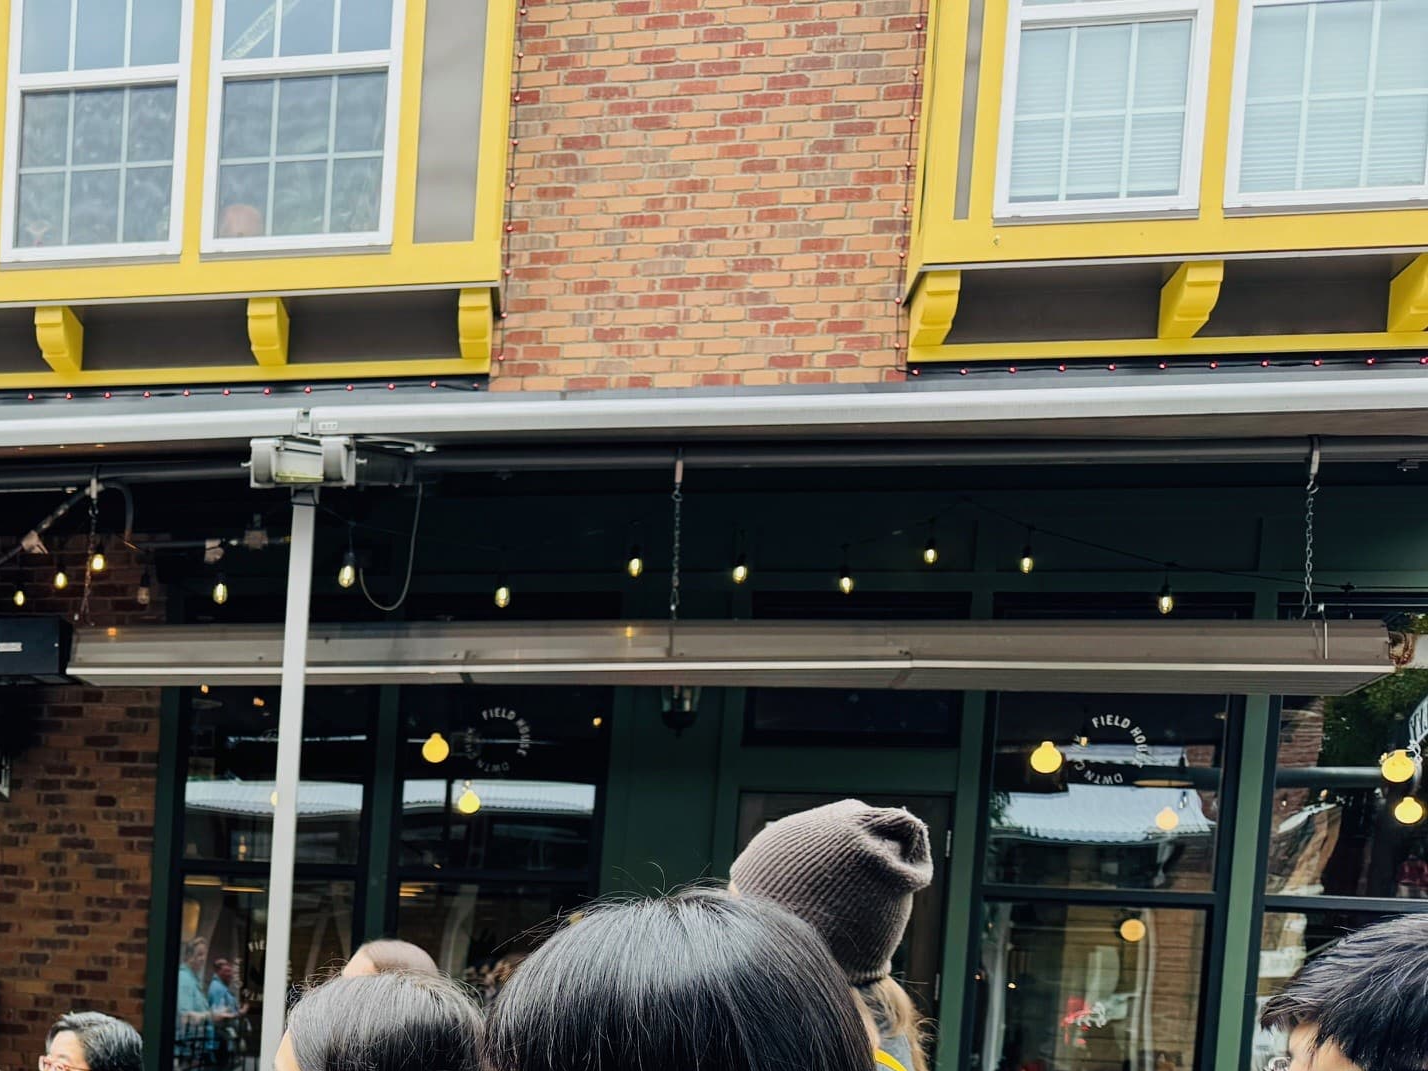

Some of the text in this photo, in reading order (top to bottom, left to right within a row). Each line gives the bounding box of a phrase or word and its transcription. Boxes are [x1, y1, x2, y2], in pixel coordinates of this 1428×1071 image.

[1091, 713, 1132, 729] FIELD
[481, 706, 532, 758] FIELD HOUSE
[1083, 769, 1124, 785] DWTN
